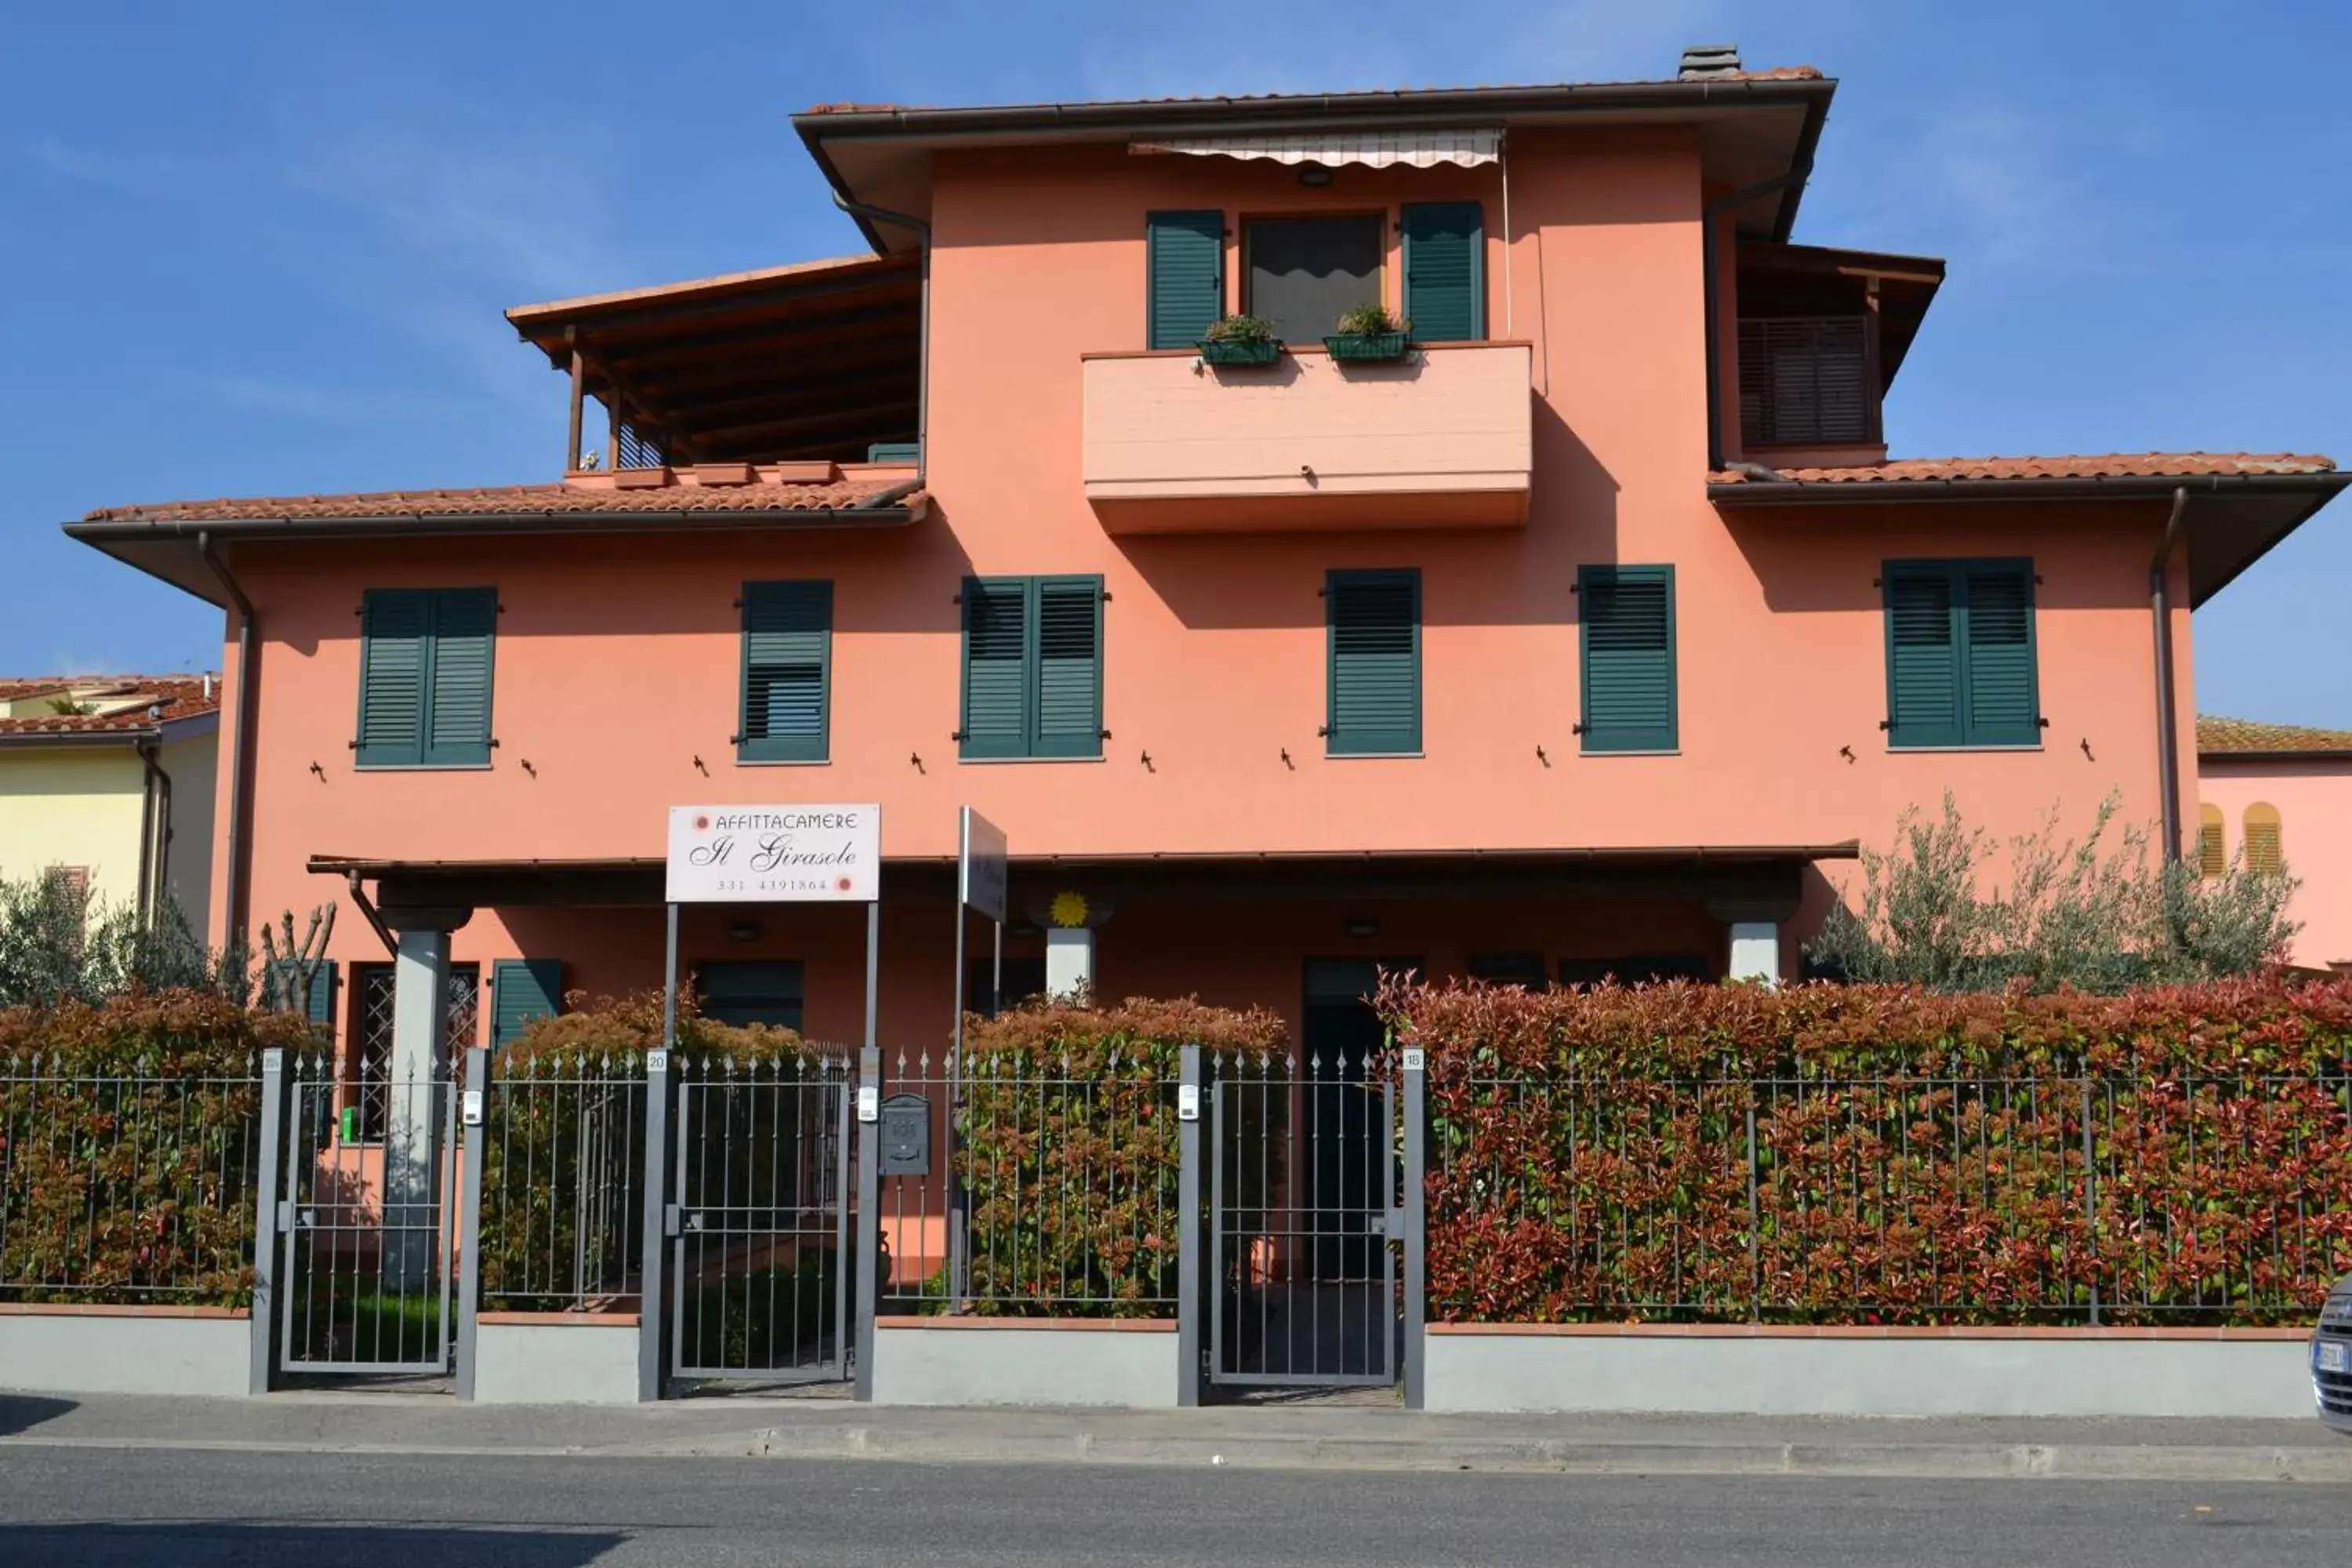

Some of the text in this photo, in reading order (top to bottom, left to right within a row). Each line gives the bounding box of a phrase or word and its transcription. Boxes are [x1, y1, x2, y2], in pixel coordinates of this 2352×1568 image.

[716, 813, 858, 829] AFFITTACAMERE
[689, 832, 858, 873] Il Girasole
[650, 1056, 664, 1067] 20
